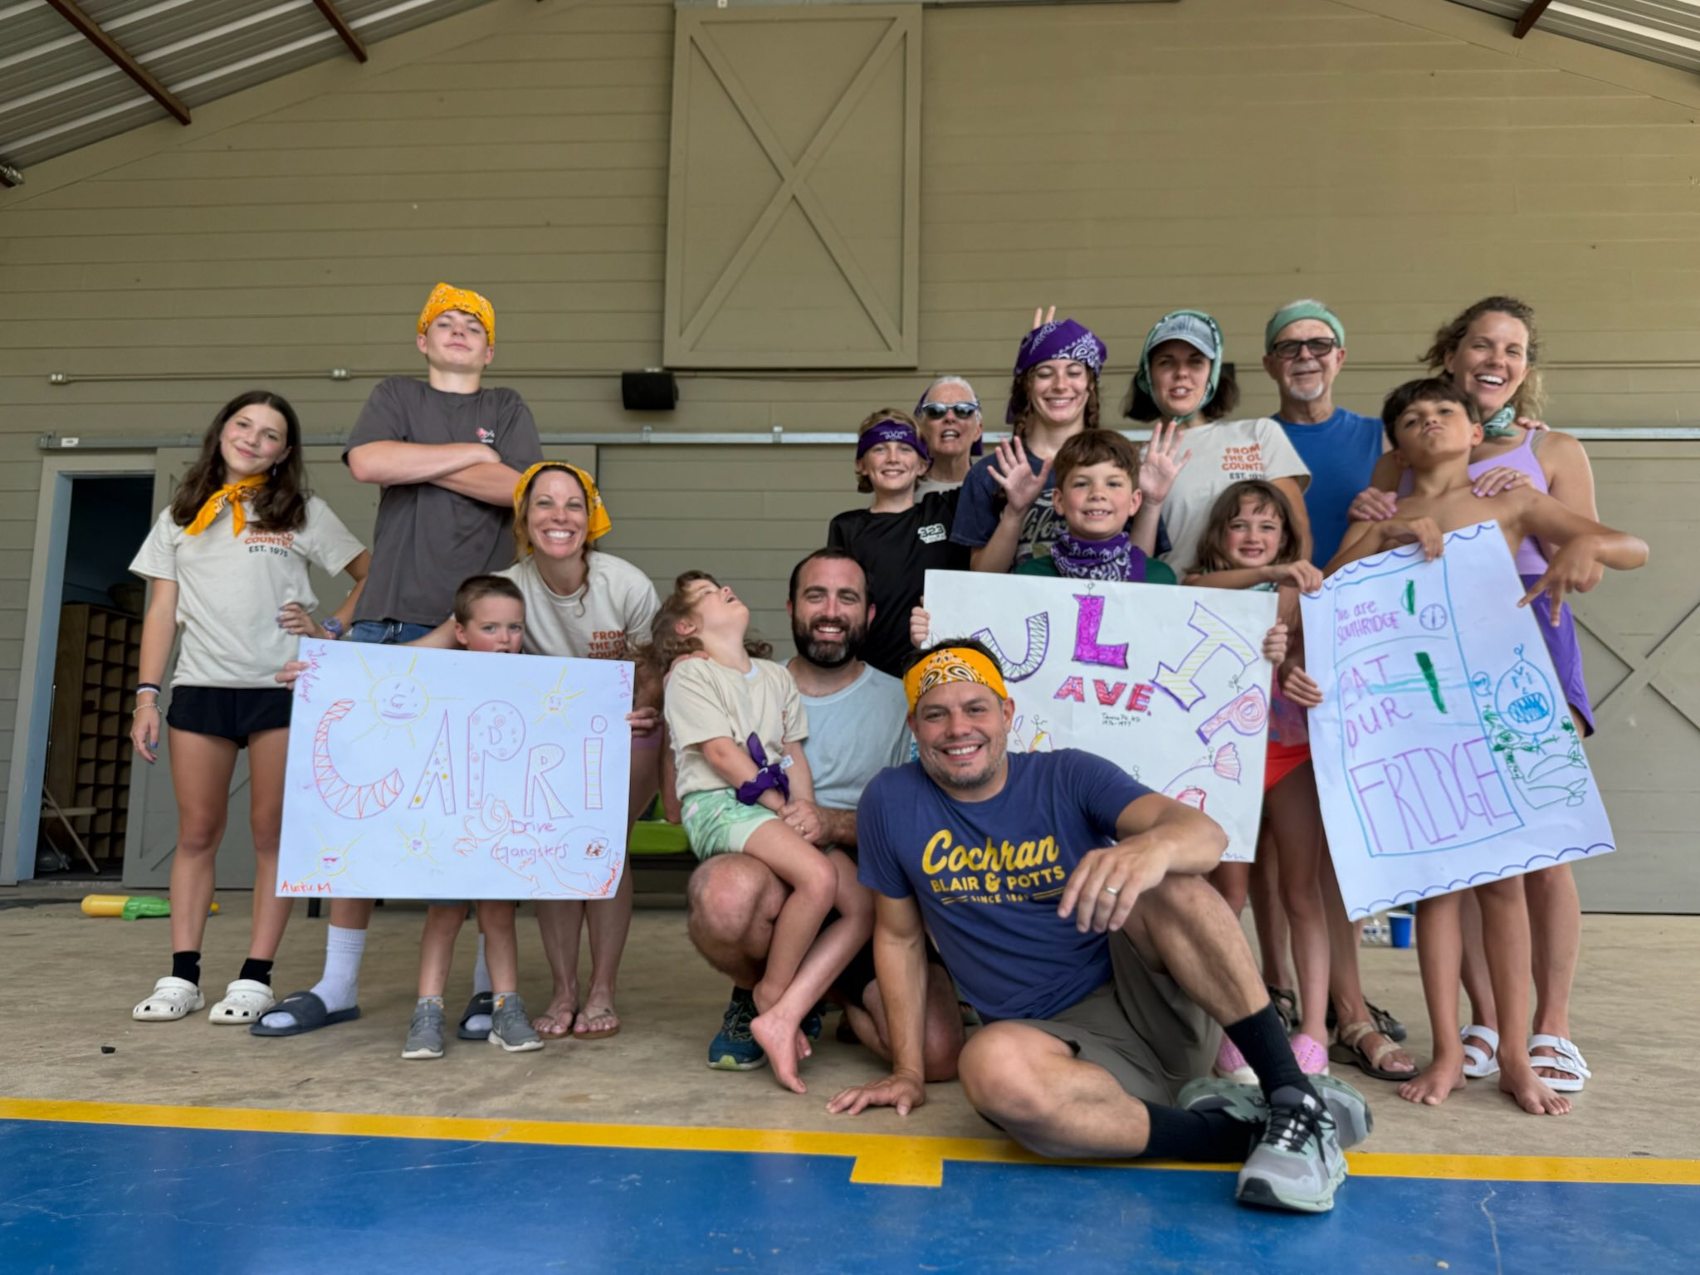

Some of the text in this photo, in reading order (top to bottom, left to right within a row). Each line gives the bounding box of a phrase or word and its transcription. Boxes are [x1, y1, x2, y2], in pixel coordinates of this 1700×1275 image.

[1222, 454, 1262, 463] THE OL
[1354, 600, 1377, 617] are
[592, 630, 625, 640] FROM
[588, 641, 609, 651] THE
[1338, 653, 1389, 711] EAT
[1345, 696, 1413, 754] OUR
[1348, 735, 1516, 853] FRIDGE
[511, 819, 557, 834] Drive
[922, 828, 1060, 876] Cochran
[930, 865, 1066, 894] BLAIR & POTTS
[970, 893, 1002, 904] SINCE
